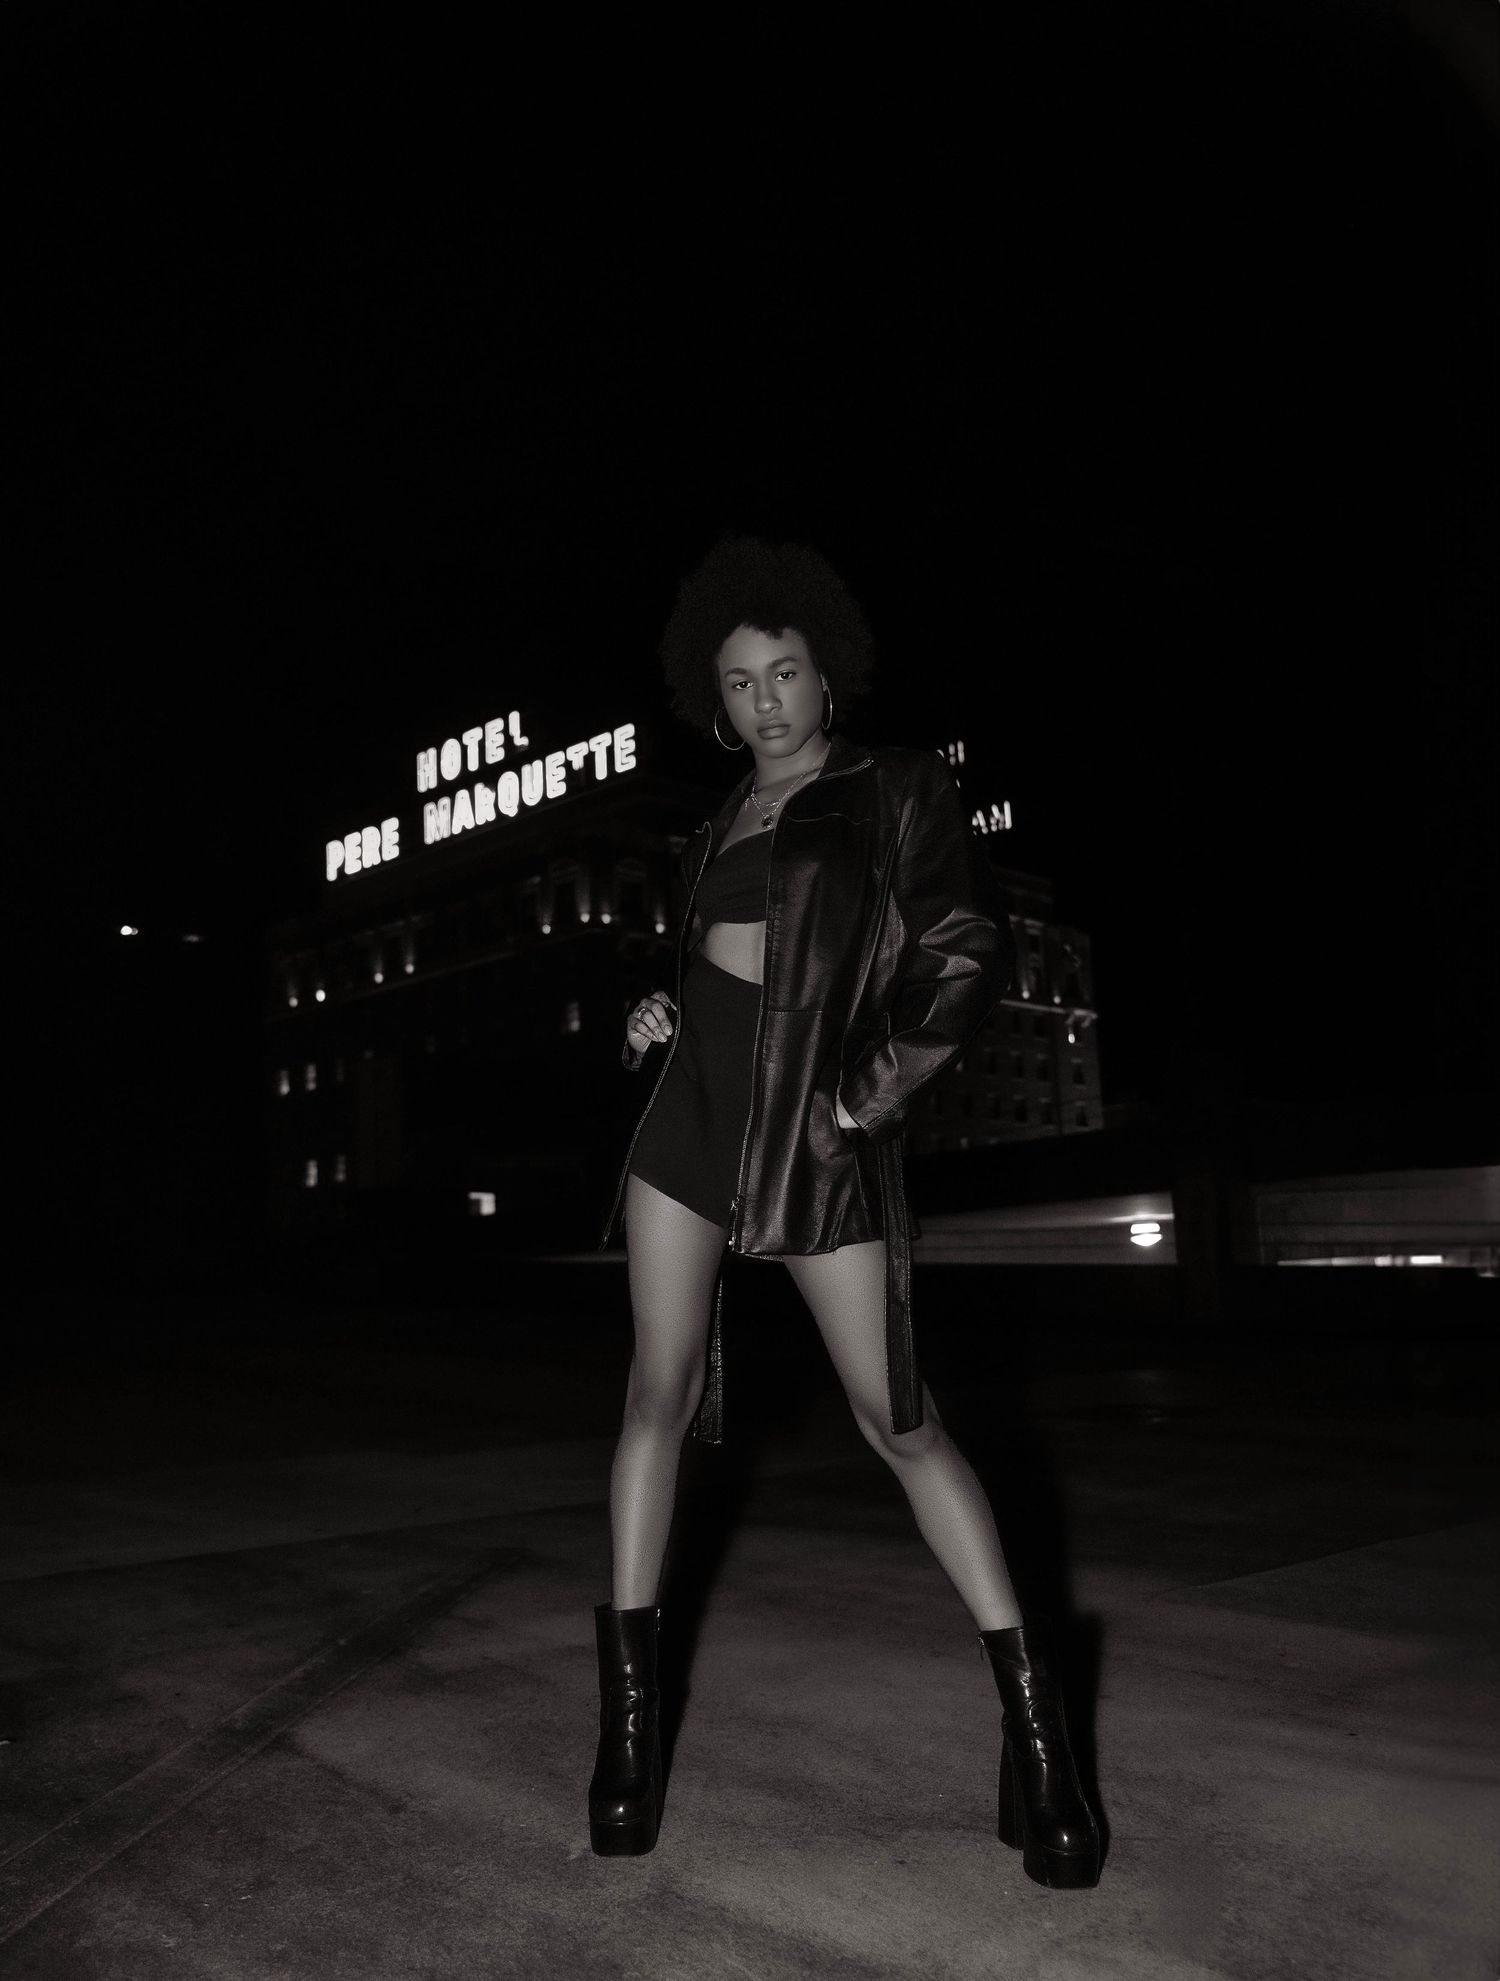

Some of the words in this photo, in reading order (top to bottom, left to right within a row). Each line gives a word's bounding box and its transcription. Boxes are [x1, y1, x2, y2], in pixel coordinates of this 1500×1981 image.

[325, 817, 400, 882] PERE
[423, 723, 637, 845] MARQUETTE
[416, 710, 529, 793] HOTEL
